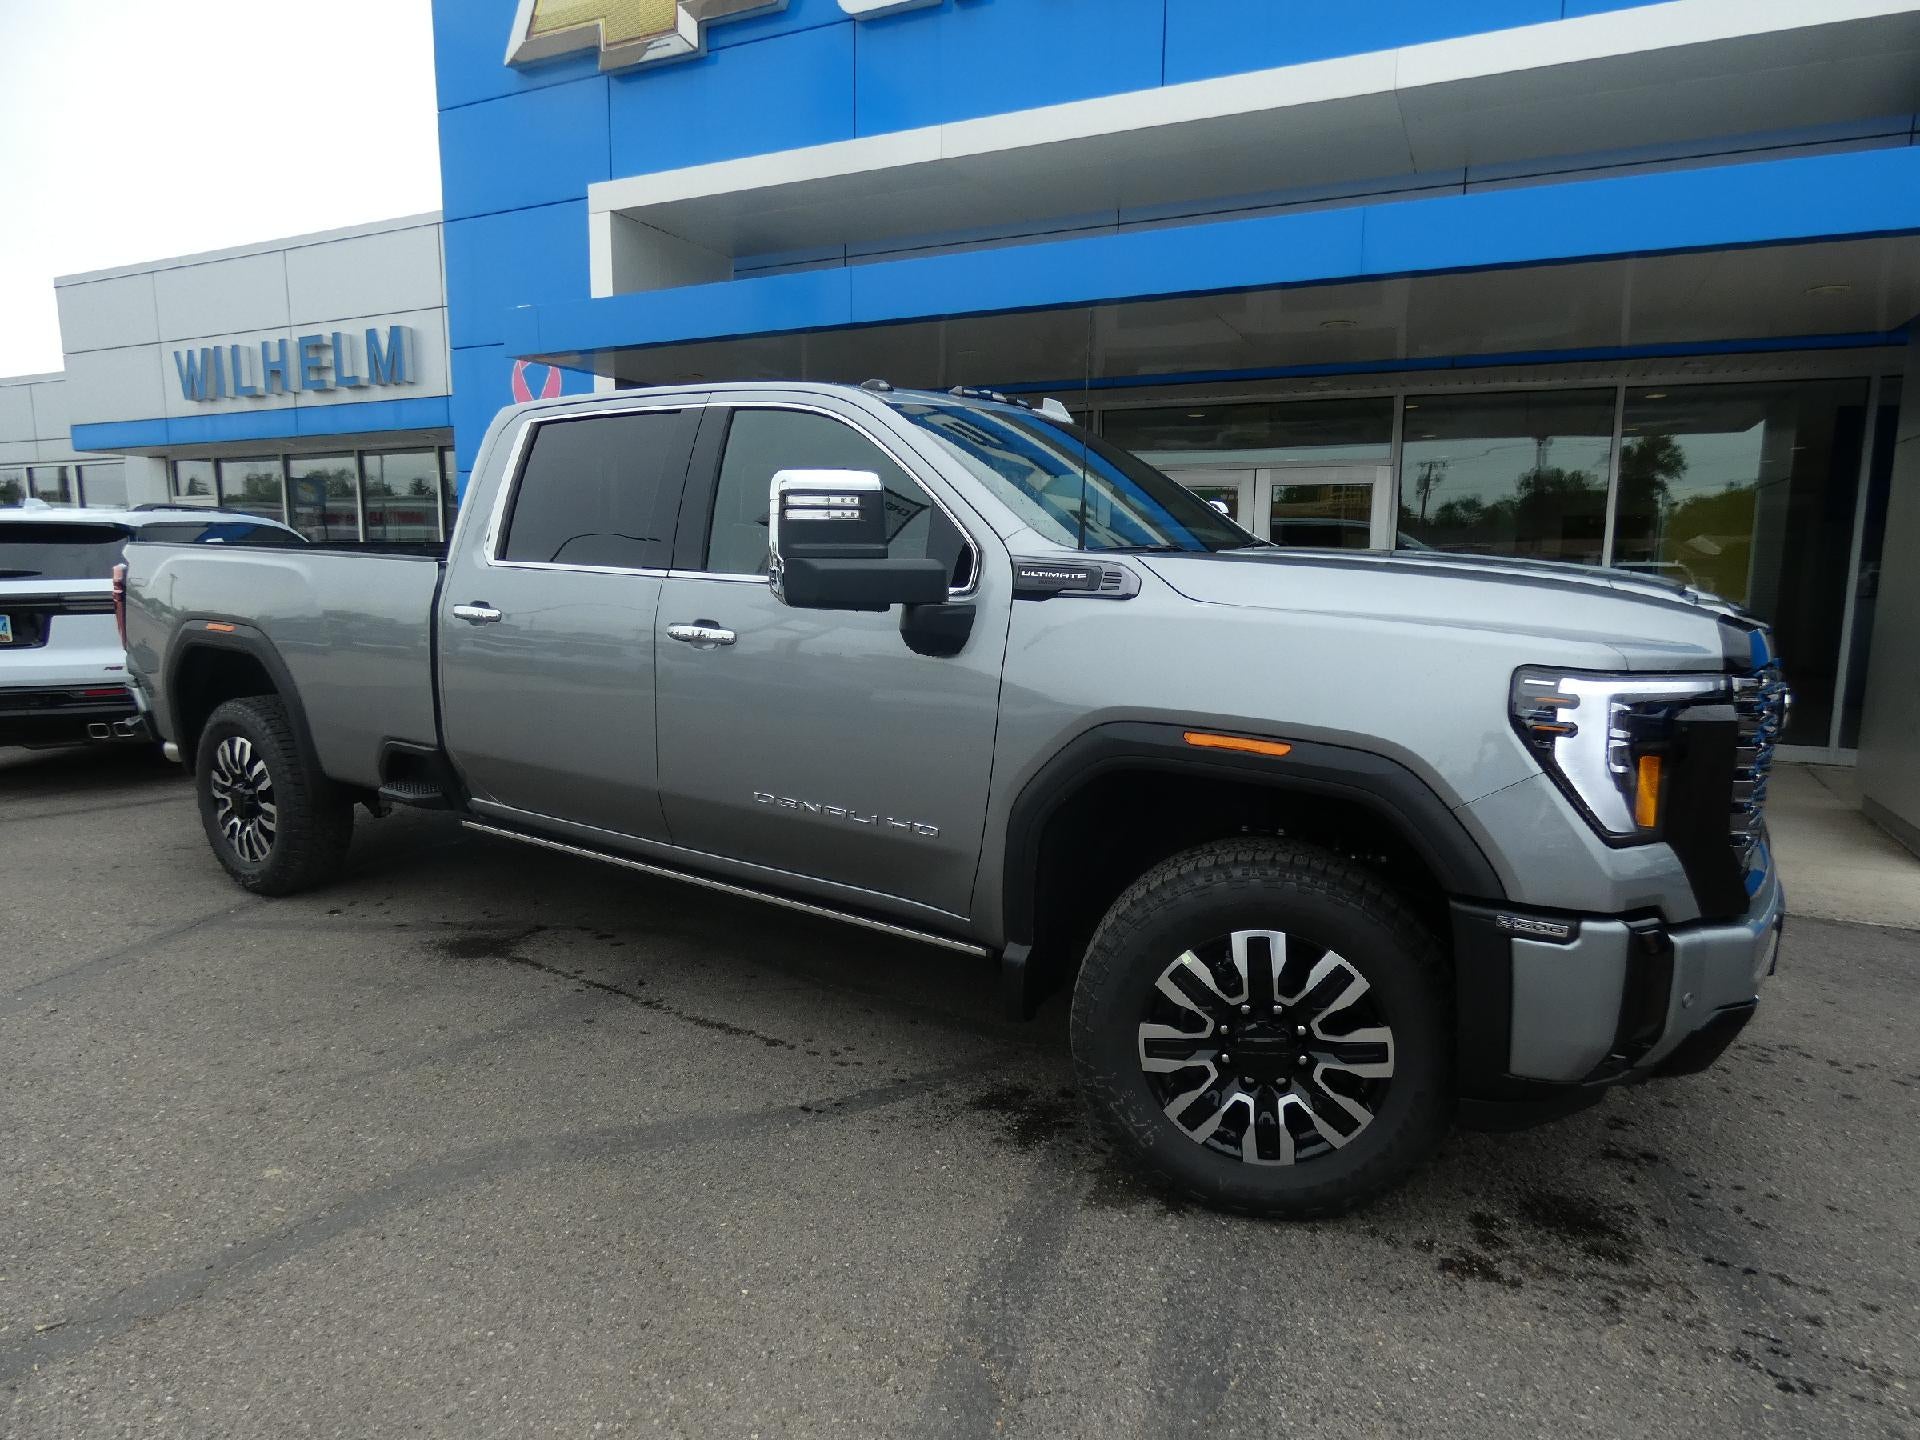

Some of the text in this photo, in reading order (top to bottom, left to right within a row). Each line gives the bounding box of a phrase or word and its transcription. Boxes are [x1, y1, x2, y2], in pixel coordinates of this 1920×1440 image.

[173, 325, 415, 403] WILHELM
[1021, 570, 1087, 579] ULTIMATE
[753, 791, 941, 839] DENALI HD
